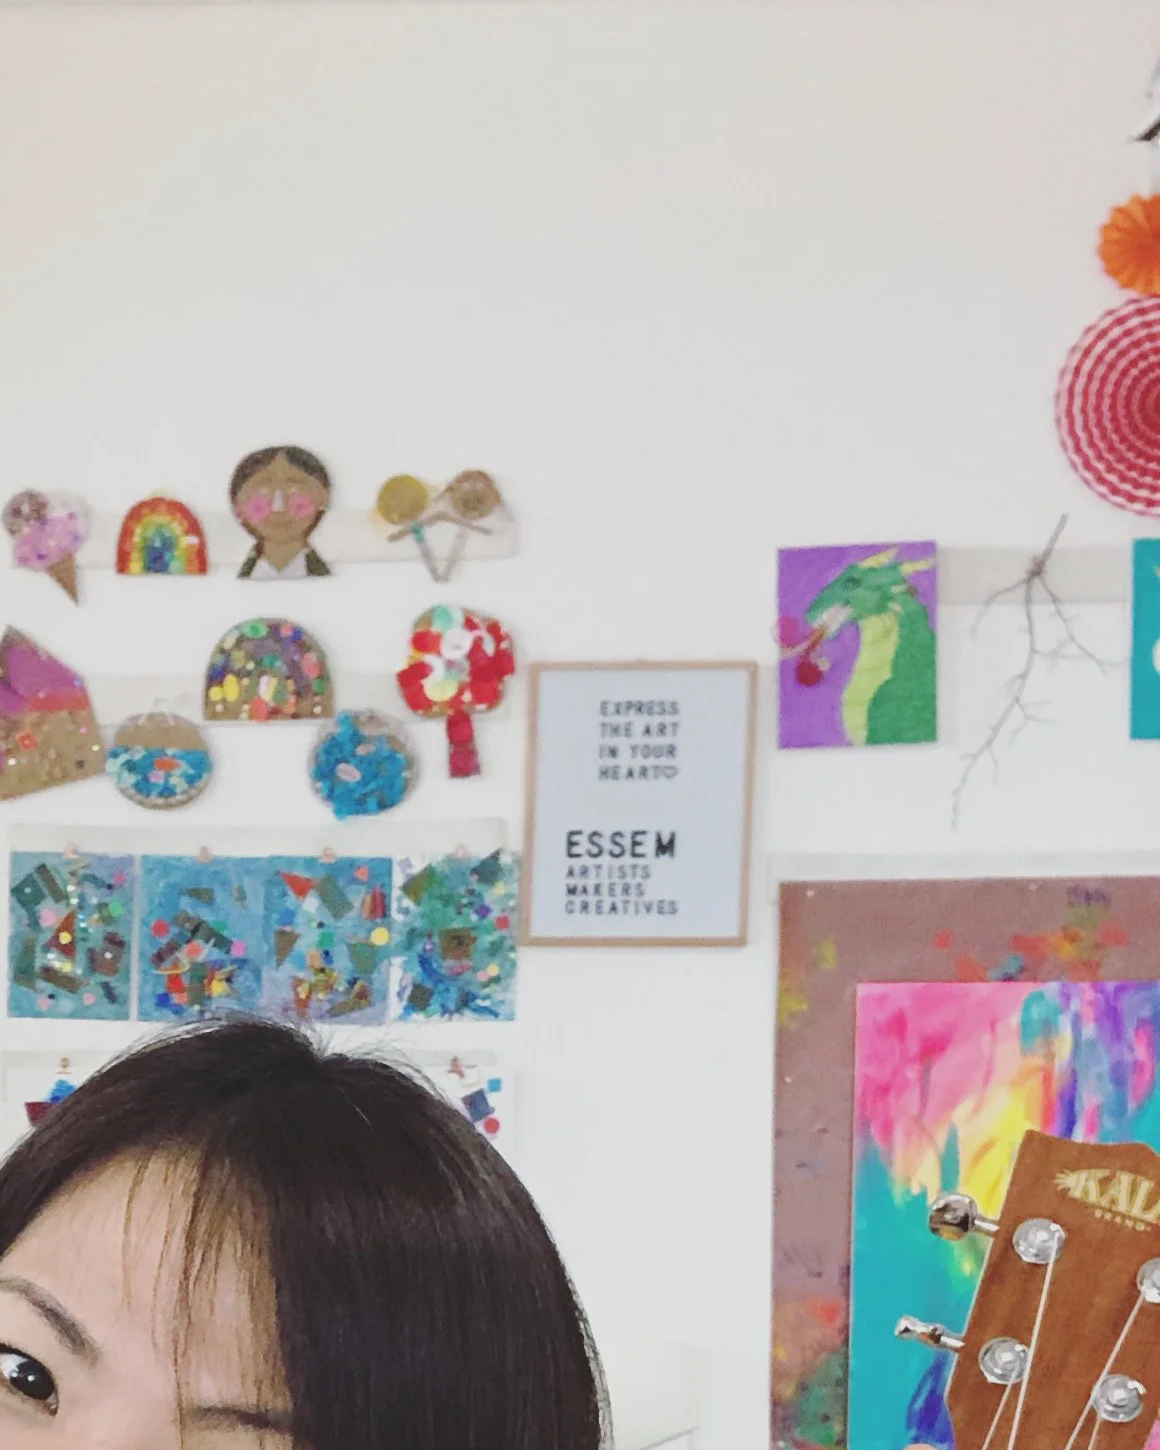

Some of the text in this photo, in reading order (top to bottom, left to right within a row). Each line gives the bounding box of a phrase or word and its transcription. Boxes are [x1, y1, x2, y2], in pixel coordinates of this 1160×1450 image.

[600, 700, 679, 716] EXPRESS
[600, 722, 679, 738] THE ART
[599, 743, 676, 760] IN YOUR
[599, 765, 660, 781] HEART
[566, 830, 676, 859] ESSEM
[566, 864, 651, 880] ARTISTS
[566, 882, 645, 898] MAKERS
[565, 900, 678, 916] CREATIVES
[1056, 1168, 1160, 1226] KAL
